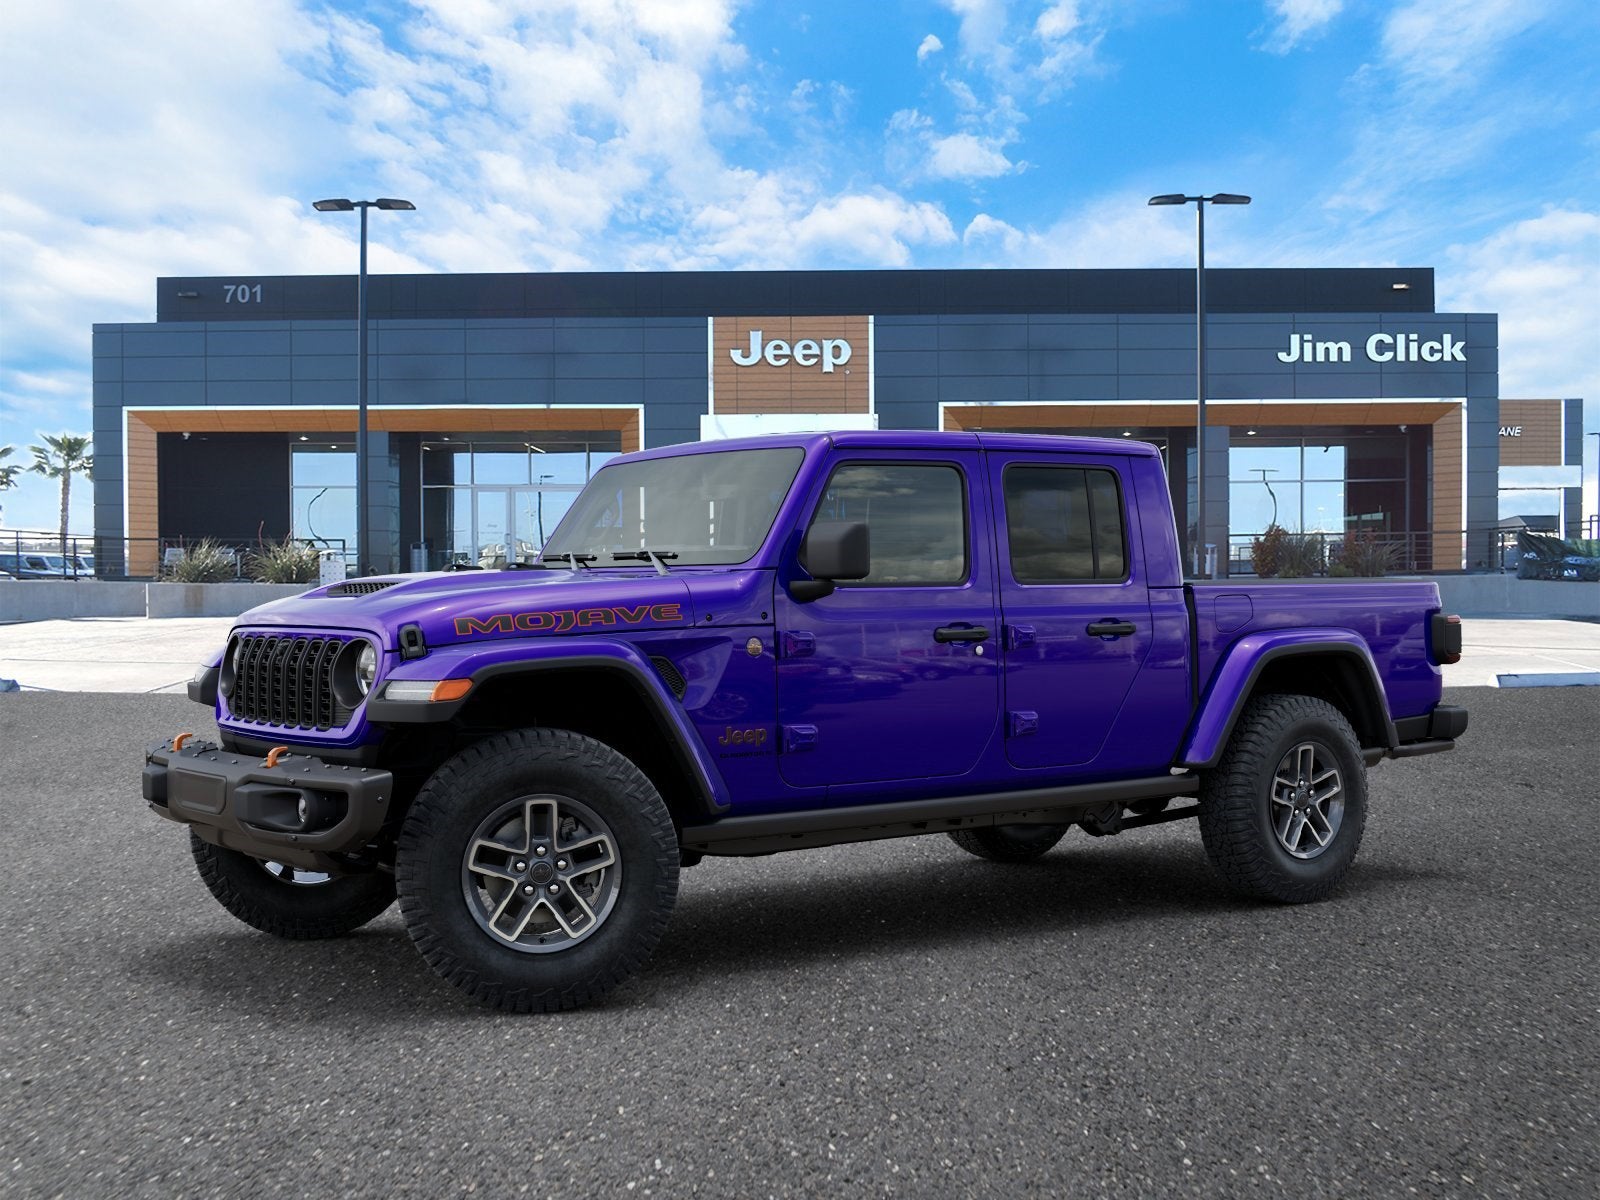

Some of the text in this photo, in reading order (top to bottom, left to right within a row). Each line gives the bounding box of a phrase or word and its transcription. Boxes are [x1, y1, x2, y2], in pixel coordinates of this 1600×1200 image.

[223, 284, 262, 304] 701
[729, 330, 852, 374] Jeep
[1277, 333, 1467, 363] Jim Click
[454, 603, 683, 636] MOJAVE
[718, 726, 767, 747] Jeep
